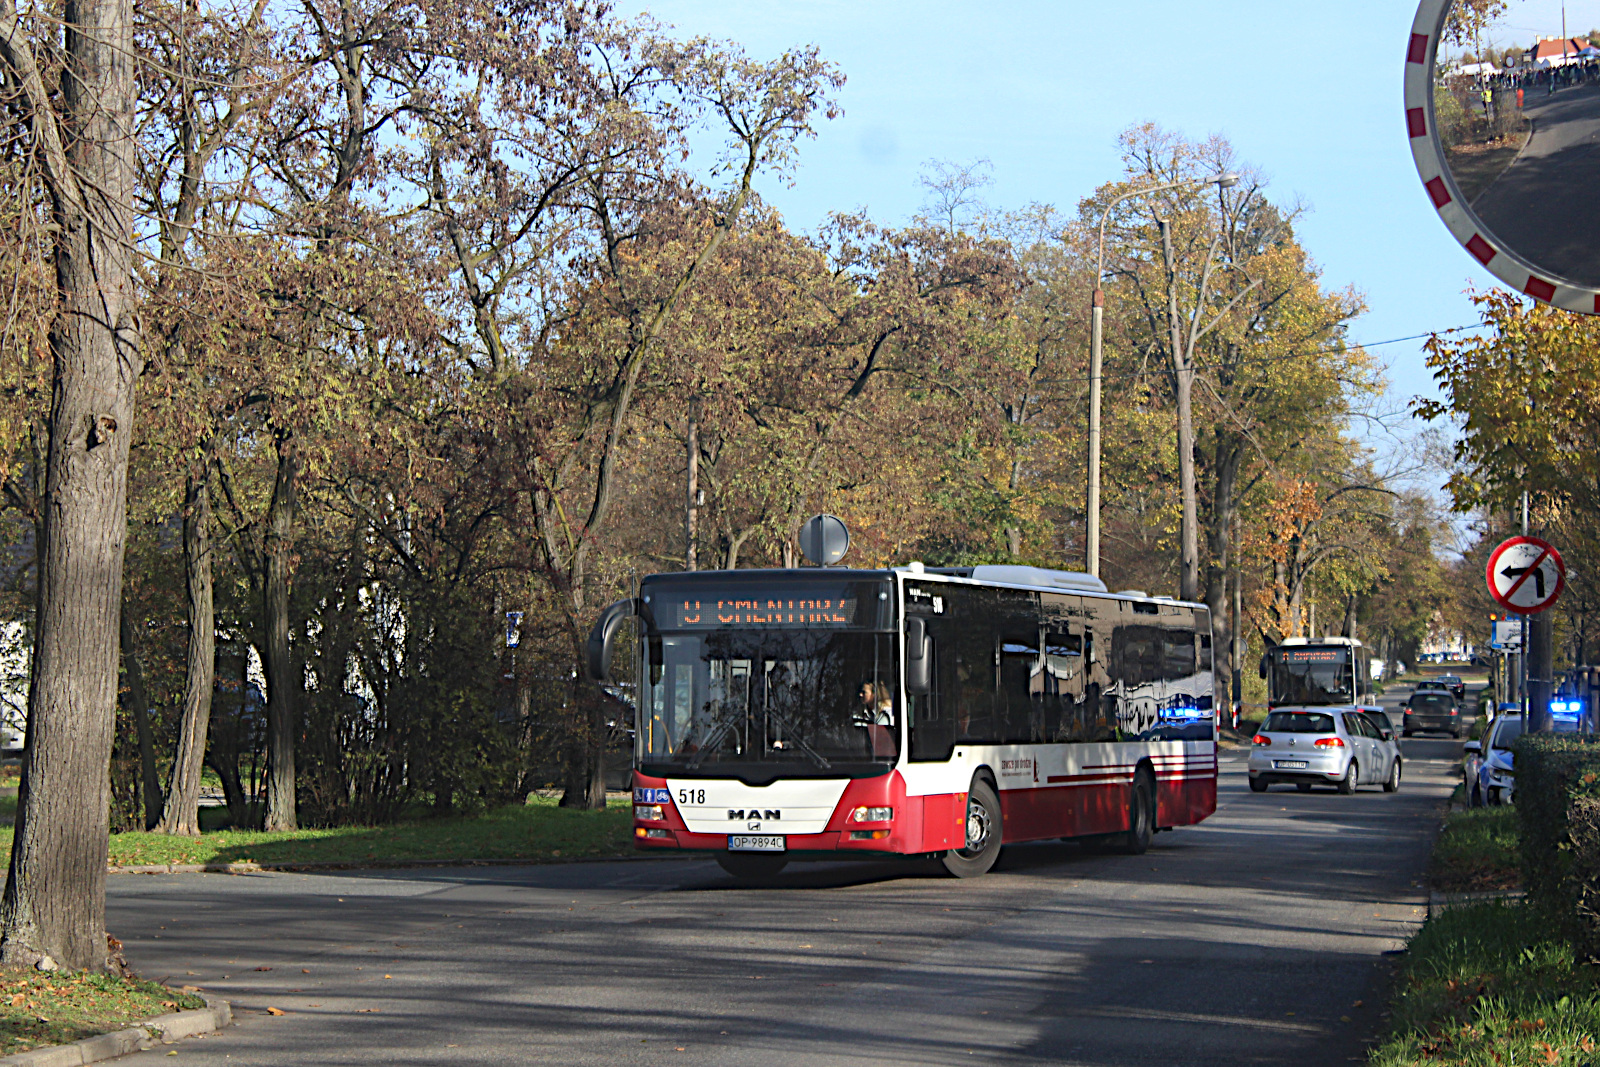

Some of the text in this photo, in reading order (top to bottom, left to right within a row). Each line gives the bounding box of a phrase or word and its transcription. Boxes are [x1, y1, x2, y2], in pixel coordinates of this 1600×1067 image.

[718, 600, 846, 622] CMENTARZ
[679, 788, 705, 804] 518
[727, 809, 781, 820] MAN
[733, 837, 748, 847] OP
[751, 837, 782, 848] 9894C
